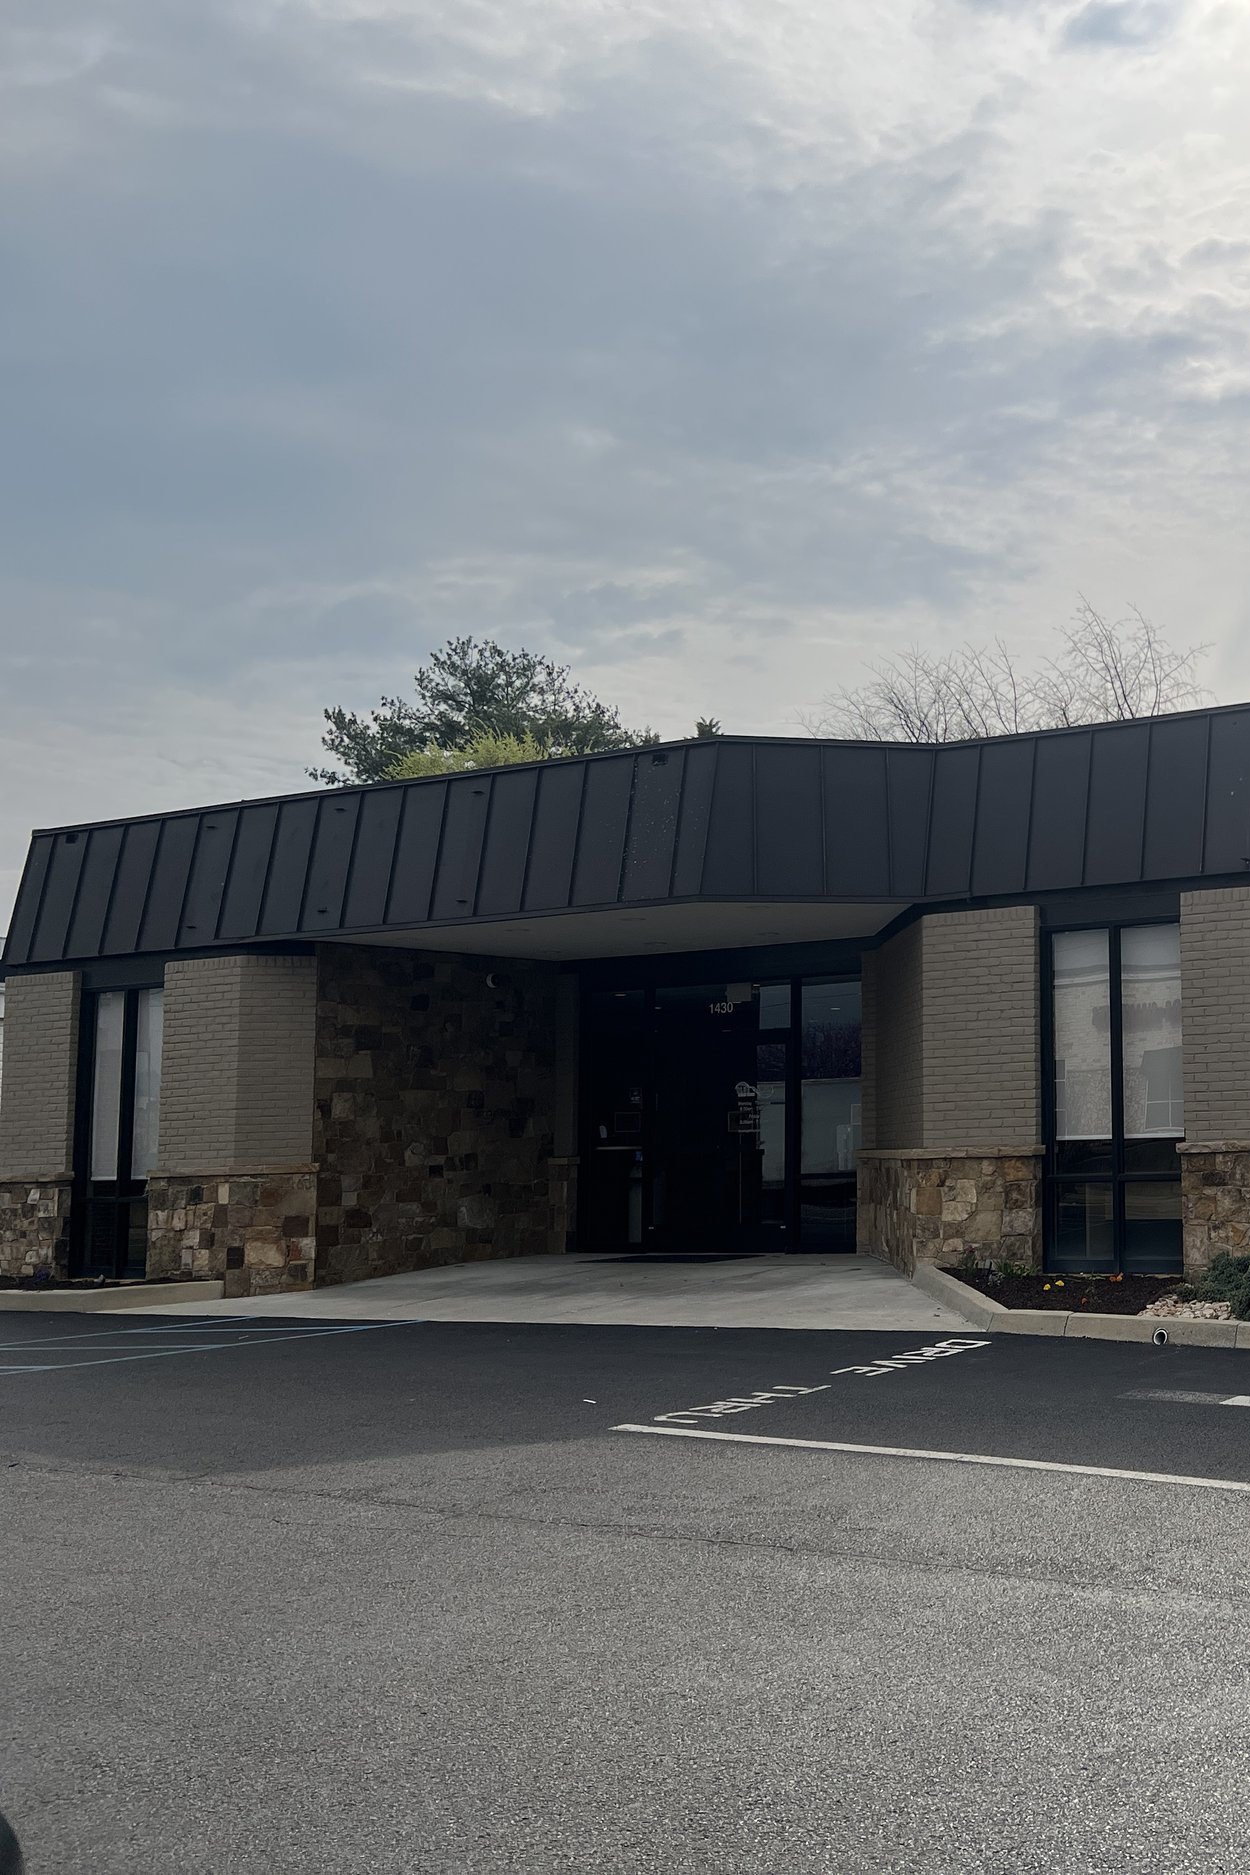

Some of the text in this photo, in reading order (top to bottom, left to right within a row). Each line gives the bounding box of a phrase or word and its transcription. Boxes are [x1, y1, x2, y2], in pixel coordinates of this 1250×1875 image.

[709, 1002, 733, 1014] 1430
[653, 1339, 992, 1424] DRIVE THRU
